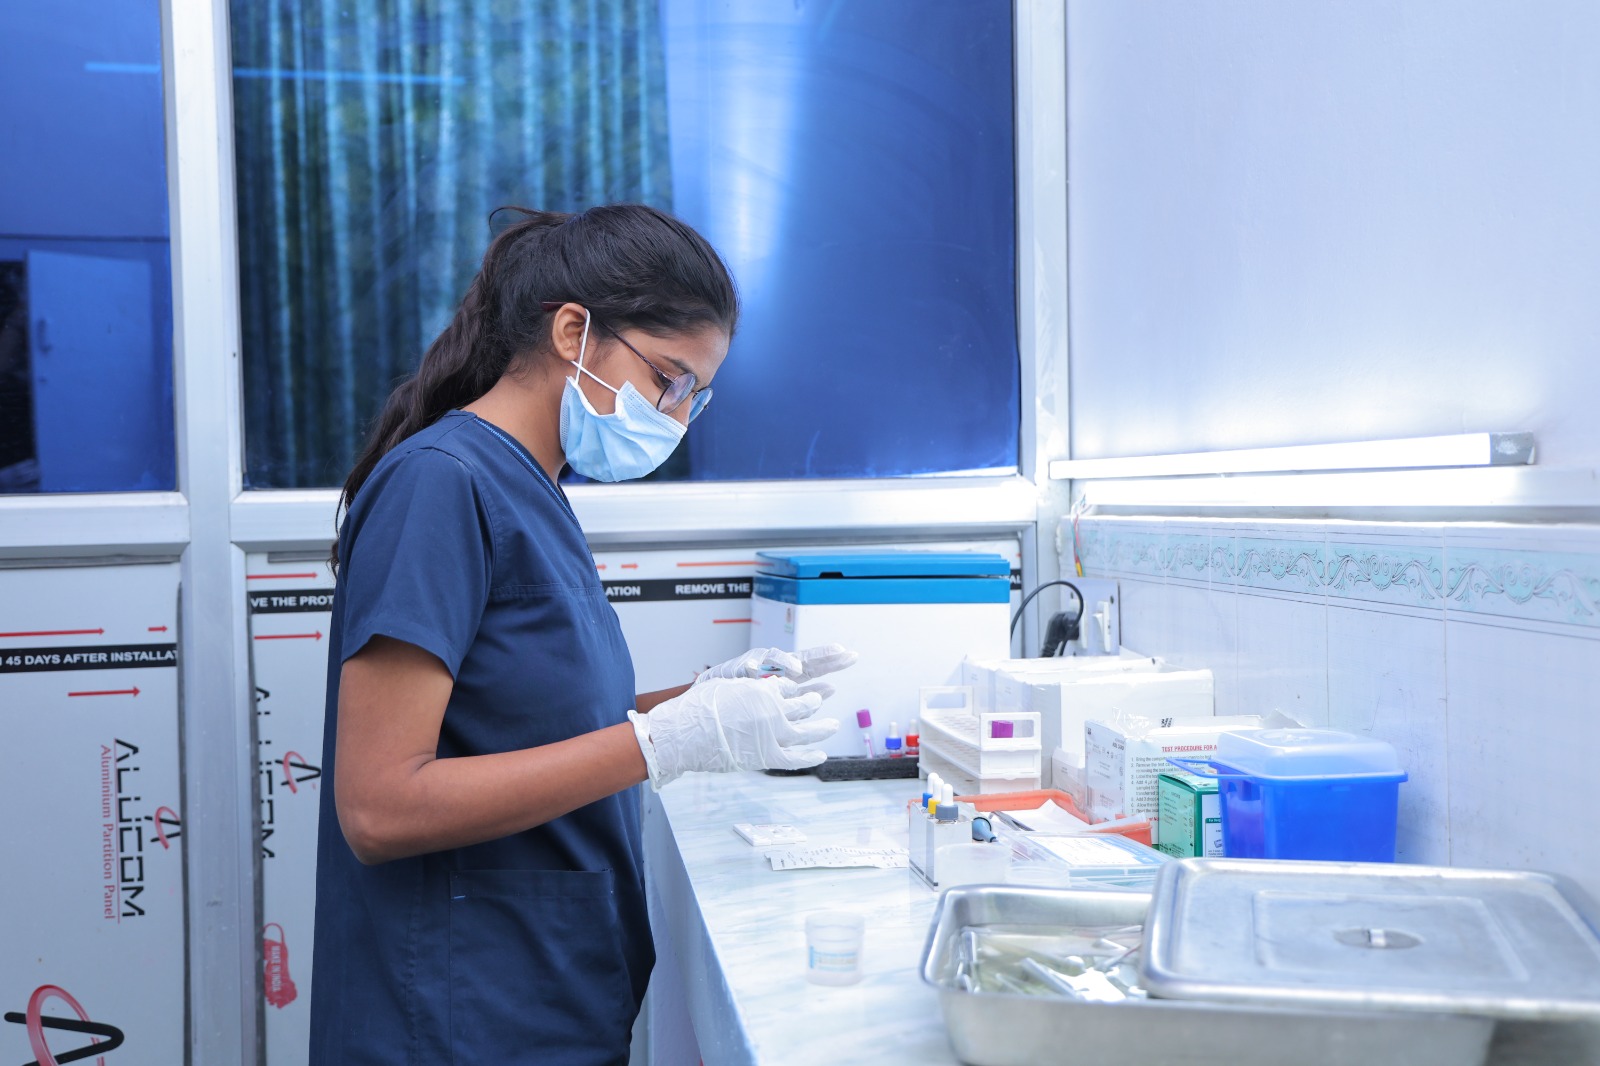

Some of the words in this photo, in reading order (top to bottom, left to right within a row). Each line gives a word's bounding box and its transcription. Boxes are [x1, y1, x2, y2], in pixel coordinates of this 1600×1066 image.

[270, 596, 297, 607] THE
[675, 583, 725, 594] REMOVE
[726, 582, 751, 593] THE
[5, 655, 21, 666] 45
[24, 654, 61, 665] DAYS
[63, 652, 108, 663] AFTER
[100, 744, 113, 818] Aluminium
[115, 739, 145, 917] ALUCOM
[102, 823, 115, 879] Partition
[103, 884, 116, 920] Panel
